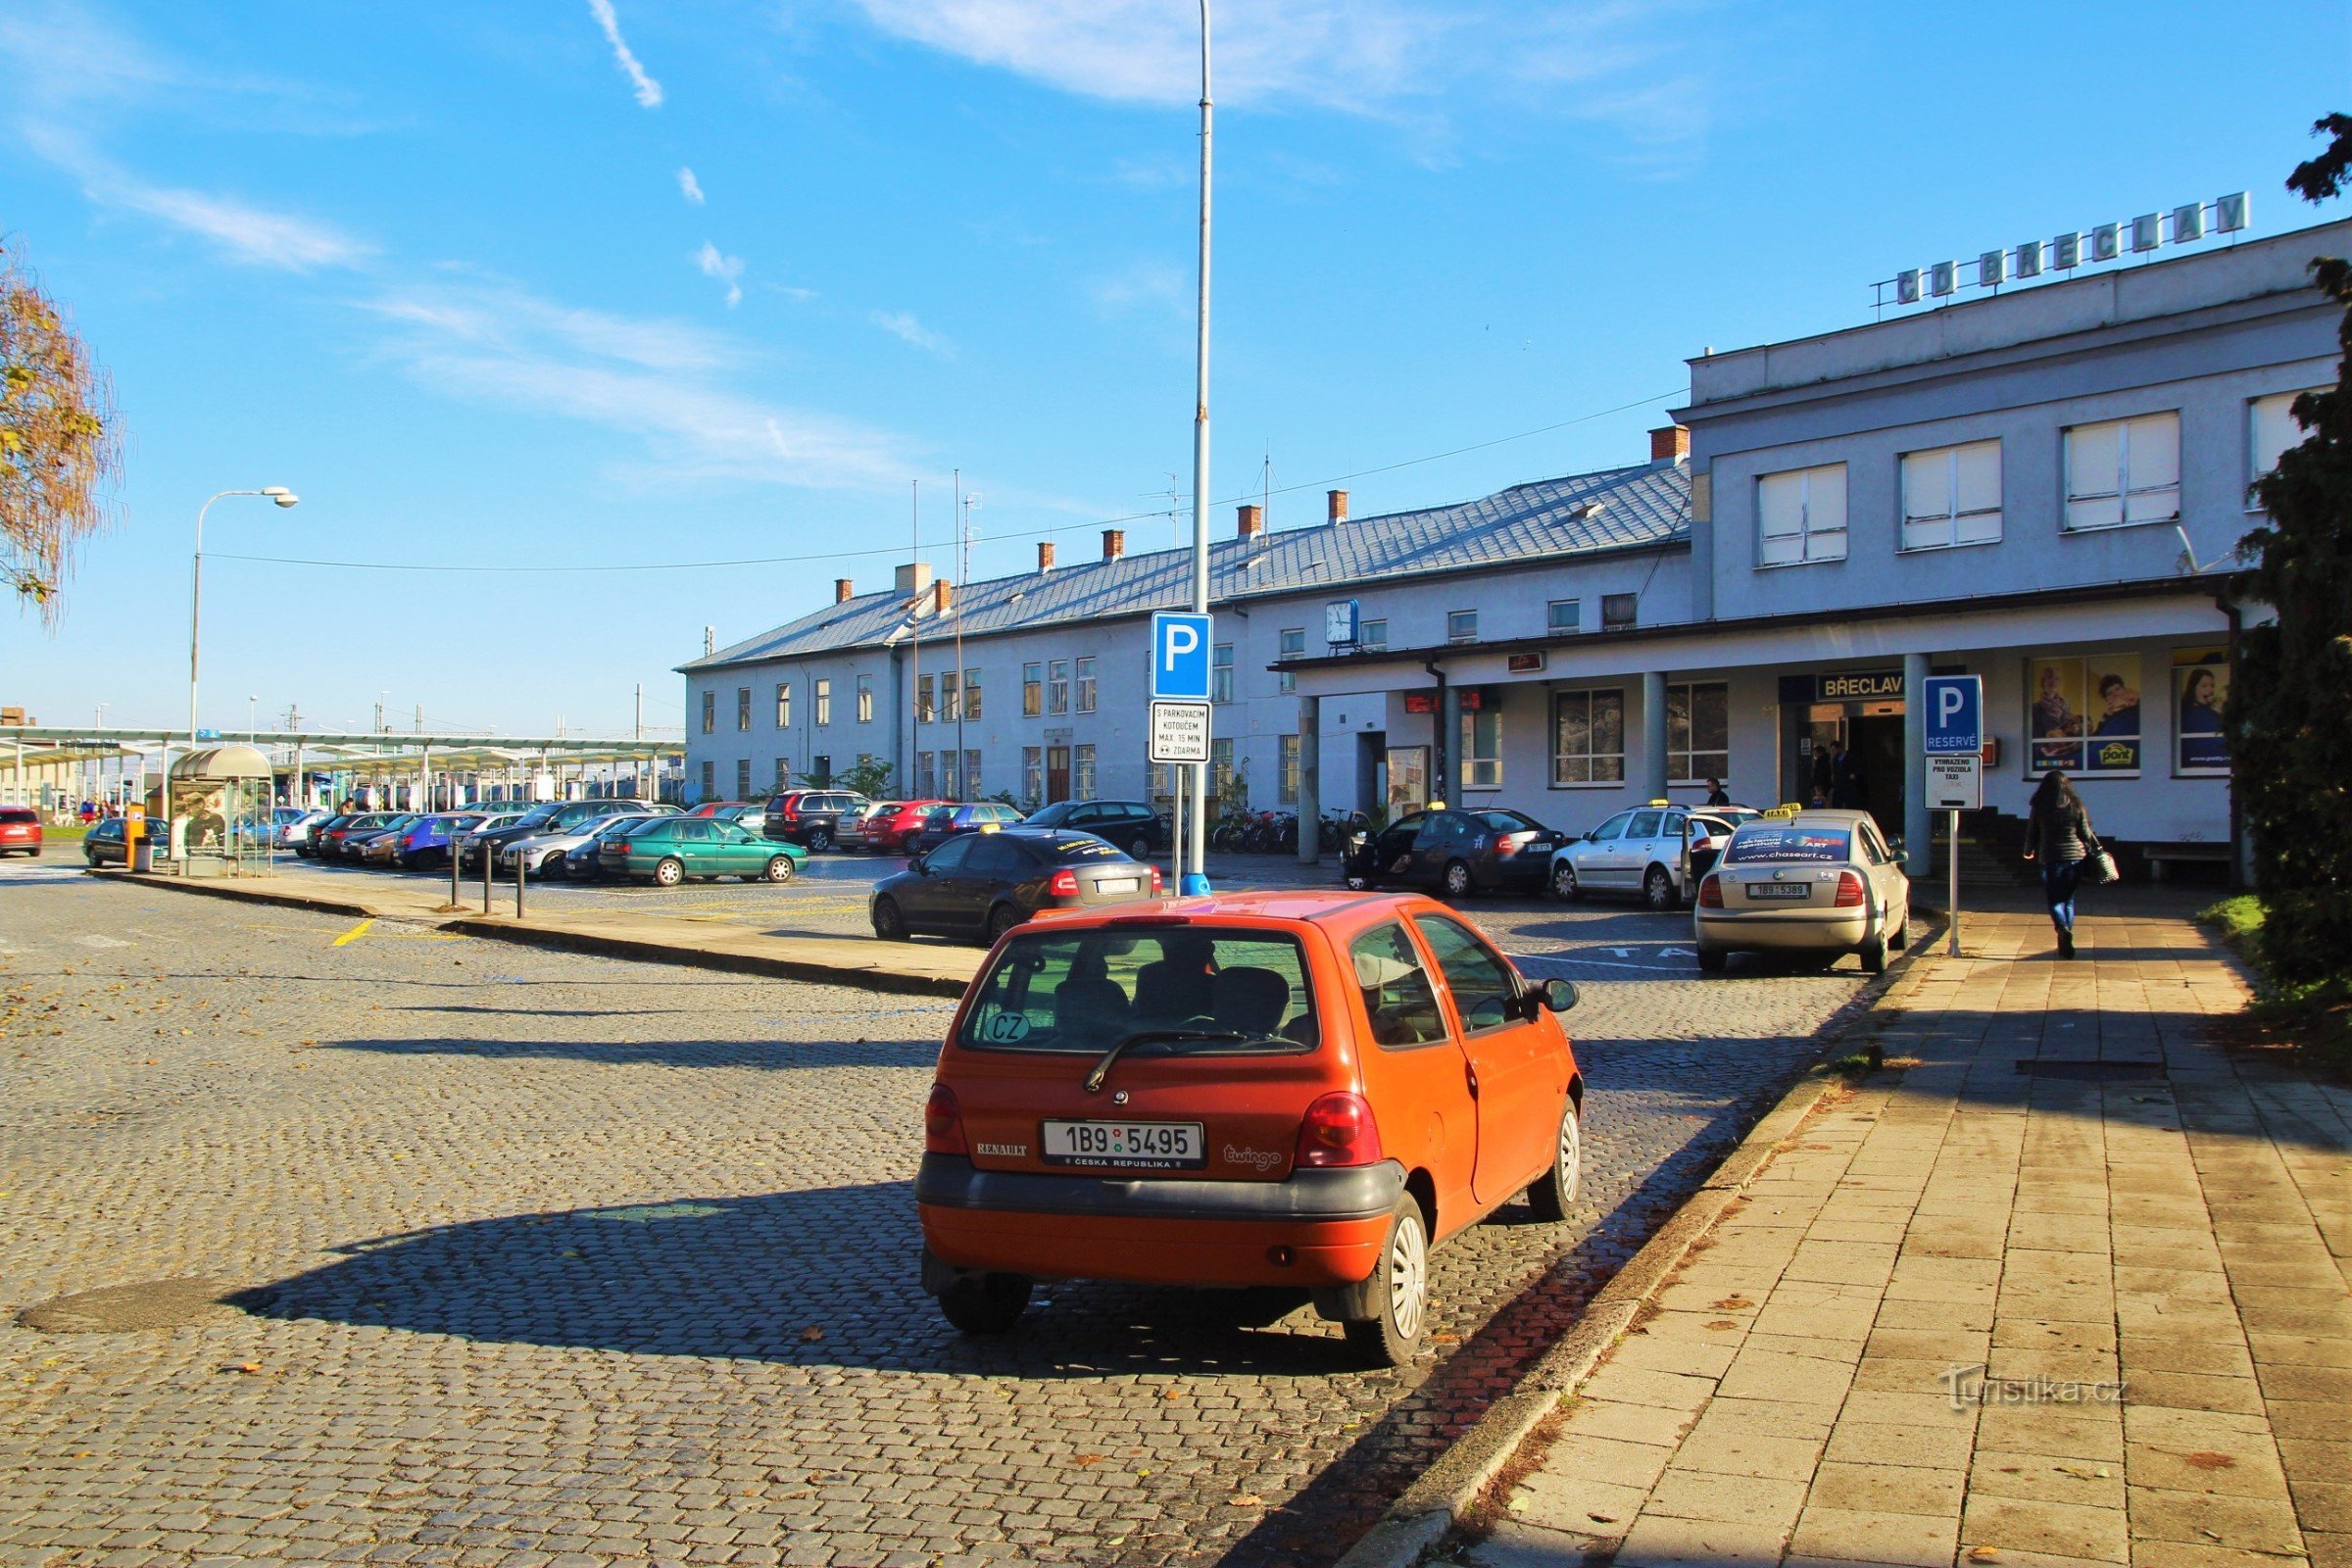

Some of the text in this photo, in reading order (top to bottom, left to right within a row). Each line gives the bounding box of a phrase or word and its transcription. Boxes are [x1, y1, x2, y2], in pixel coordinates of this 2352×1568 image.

[1165, 623, 1199, 671] P
[1825, 675, 1903, 696] BŘECLAV
[1156, 708, 1205, 719] S PARKOVACÍM
[1938, 686, 1964, 729] P
[1163, 719, 1199, 731] KOTOUČEM
[1178, 734, 1186, 743] 15
[1928, 733, 1977, 748] RESERVÉ
[1173, 746, 1200, 756] ZDARMA
[1738, 851, 1833, 861] www.chaseart.cz
[1780, 885, 1803, 895] 5389
[993, 1014, 1022, 1040] CZ
[1066, 1126, 1189, 1155] 1B9 5495
[976, 1143, 1027, 1156] RENAULT
[1113, 1159, 1171, 1168] REPUBLIKA
[1223, 1144, 1282, 1172] twingo
